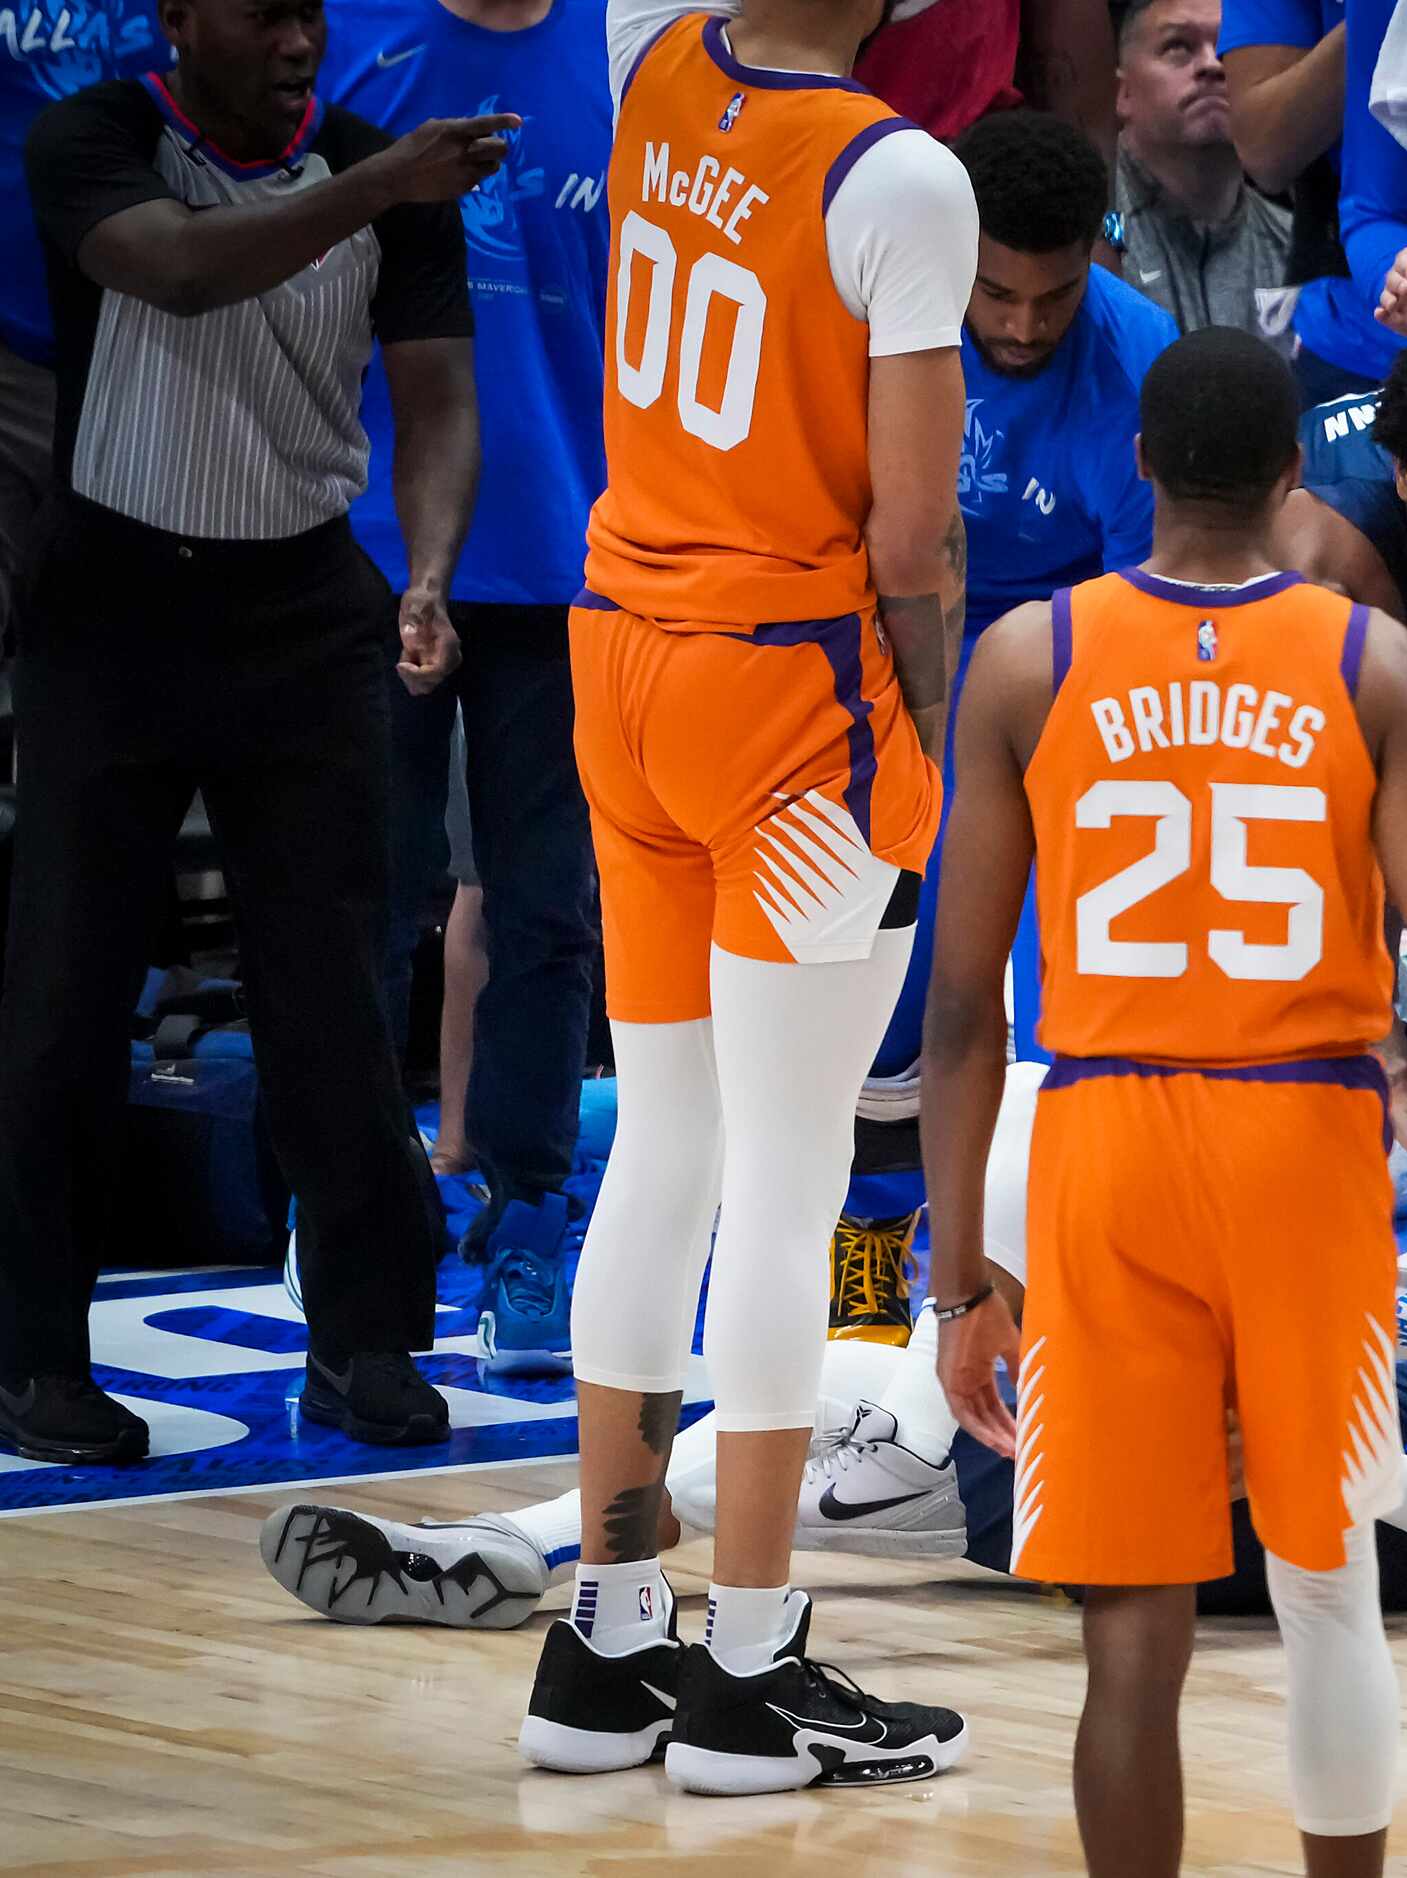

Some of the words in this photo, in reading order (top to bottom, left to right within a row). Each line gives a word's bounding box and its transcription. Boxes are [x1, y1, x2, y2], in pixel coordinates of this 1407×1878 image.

[555, 170, 606, 213] IN
[642, 141, 769, 245] McGEE
[616, 209, 767, 451] 00
[1090, 680, 1326, 768] BRIDGES
[1075, 780, 1326, 981] 25
